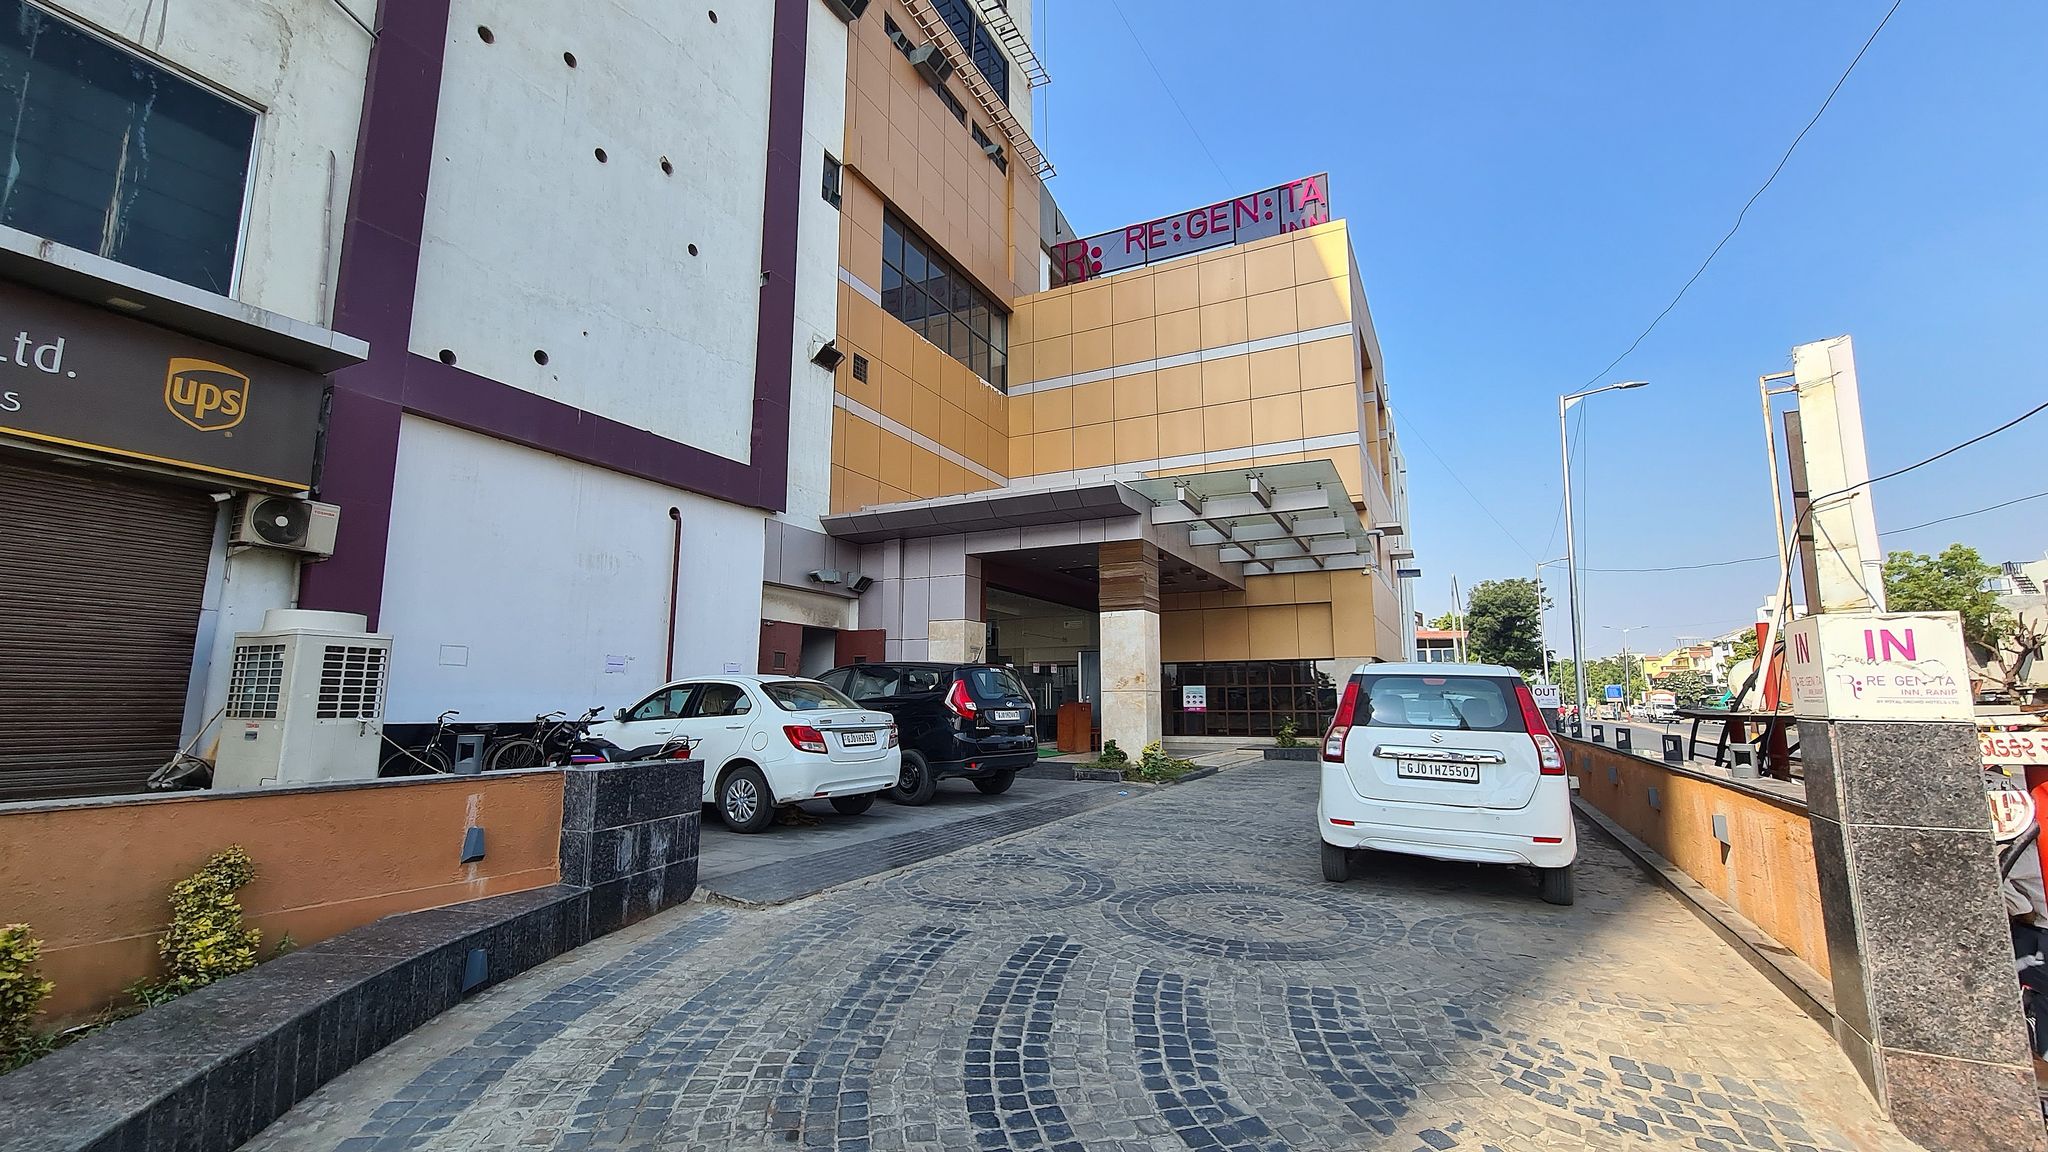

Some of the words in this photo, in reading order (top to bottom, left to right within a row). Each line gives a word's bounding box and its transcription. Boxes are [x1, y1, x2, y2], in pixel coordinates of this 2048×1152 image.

[0, 331, 77, 378] td.
[172, 376, 241, 419] ups
[1794, 632, 1811, 664] IN
[1864, 628, 1917, 662] IN
[1534, 687, 1556, 697] OUT
[1926, 688, 1958, 697] RANIP
[1407, 761, 1476, 778] GJ01HZ5507
